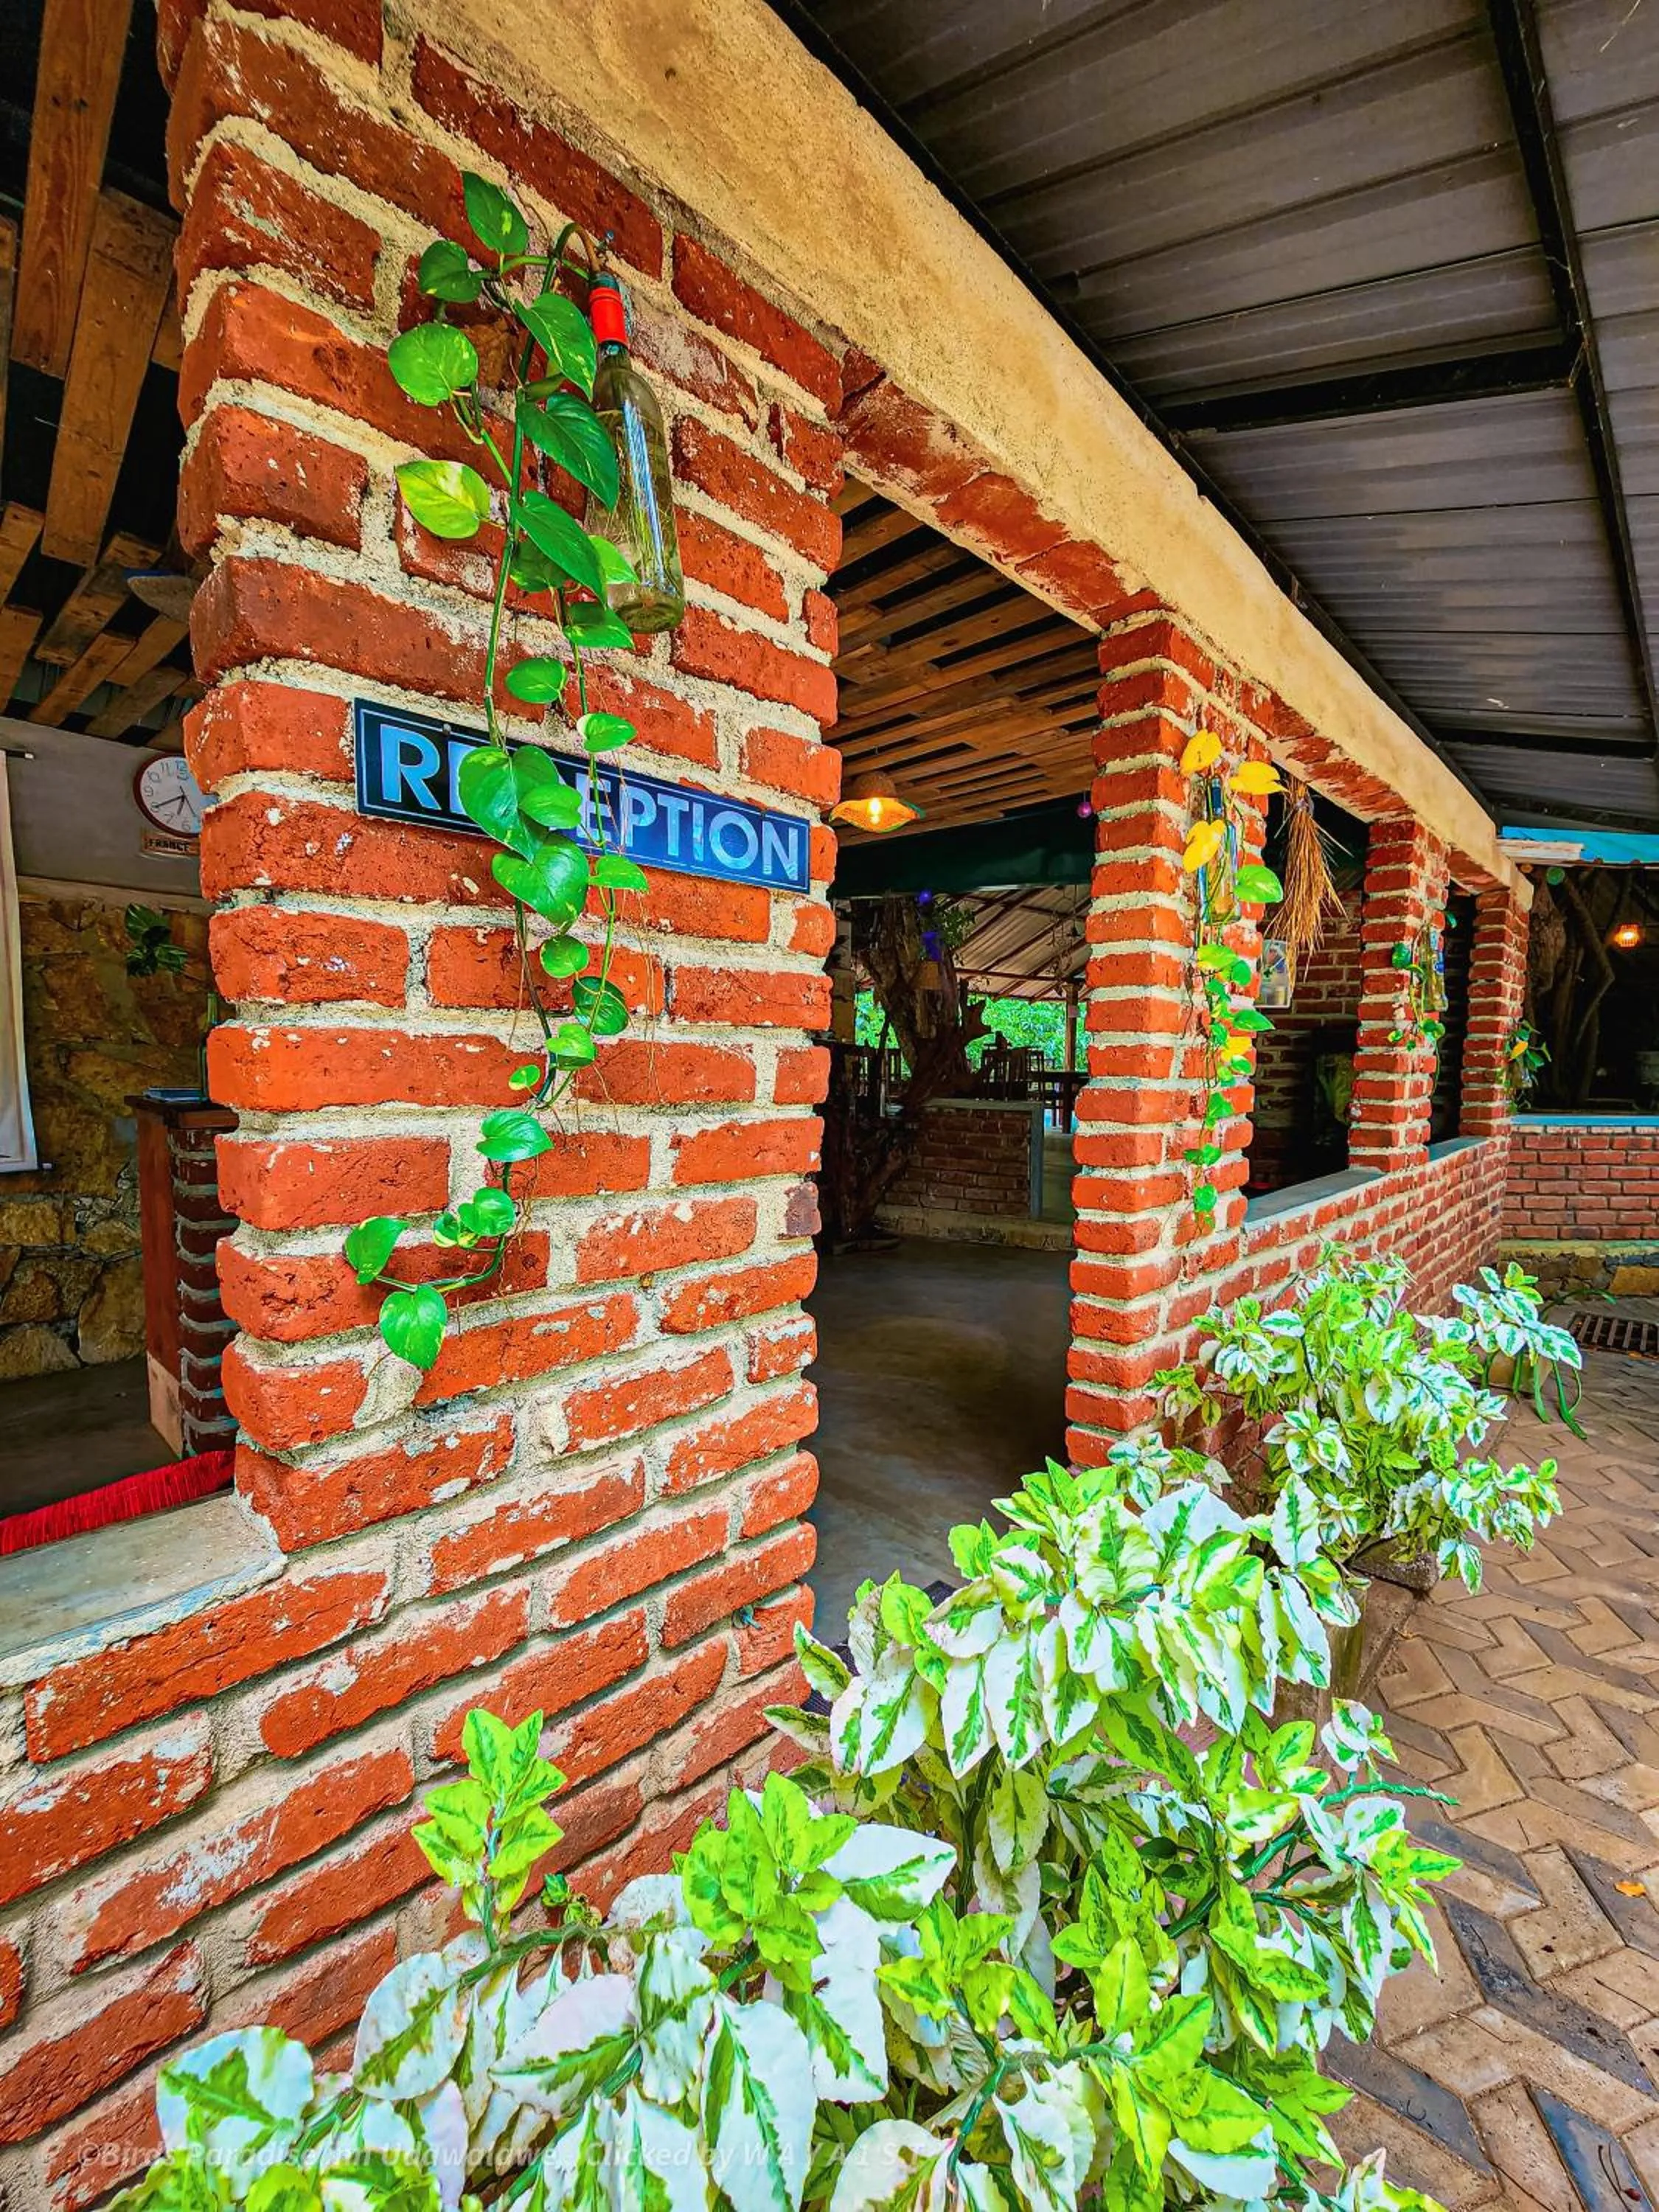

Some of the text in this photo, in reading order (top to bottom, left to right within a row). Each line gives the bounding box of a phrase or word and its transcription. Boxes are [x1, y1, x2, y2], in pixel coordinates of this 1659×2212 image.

[144, 785, 154, 797] 9
[380, 723, 798, 880] REPTION
[164, 812, 175, 824] 7
[181, 818, 191, 831] 6
